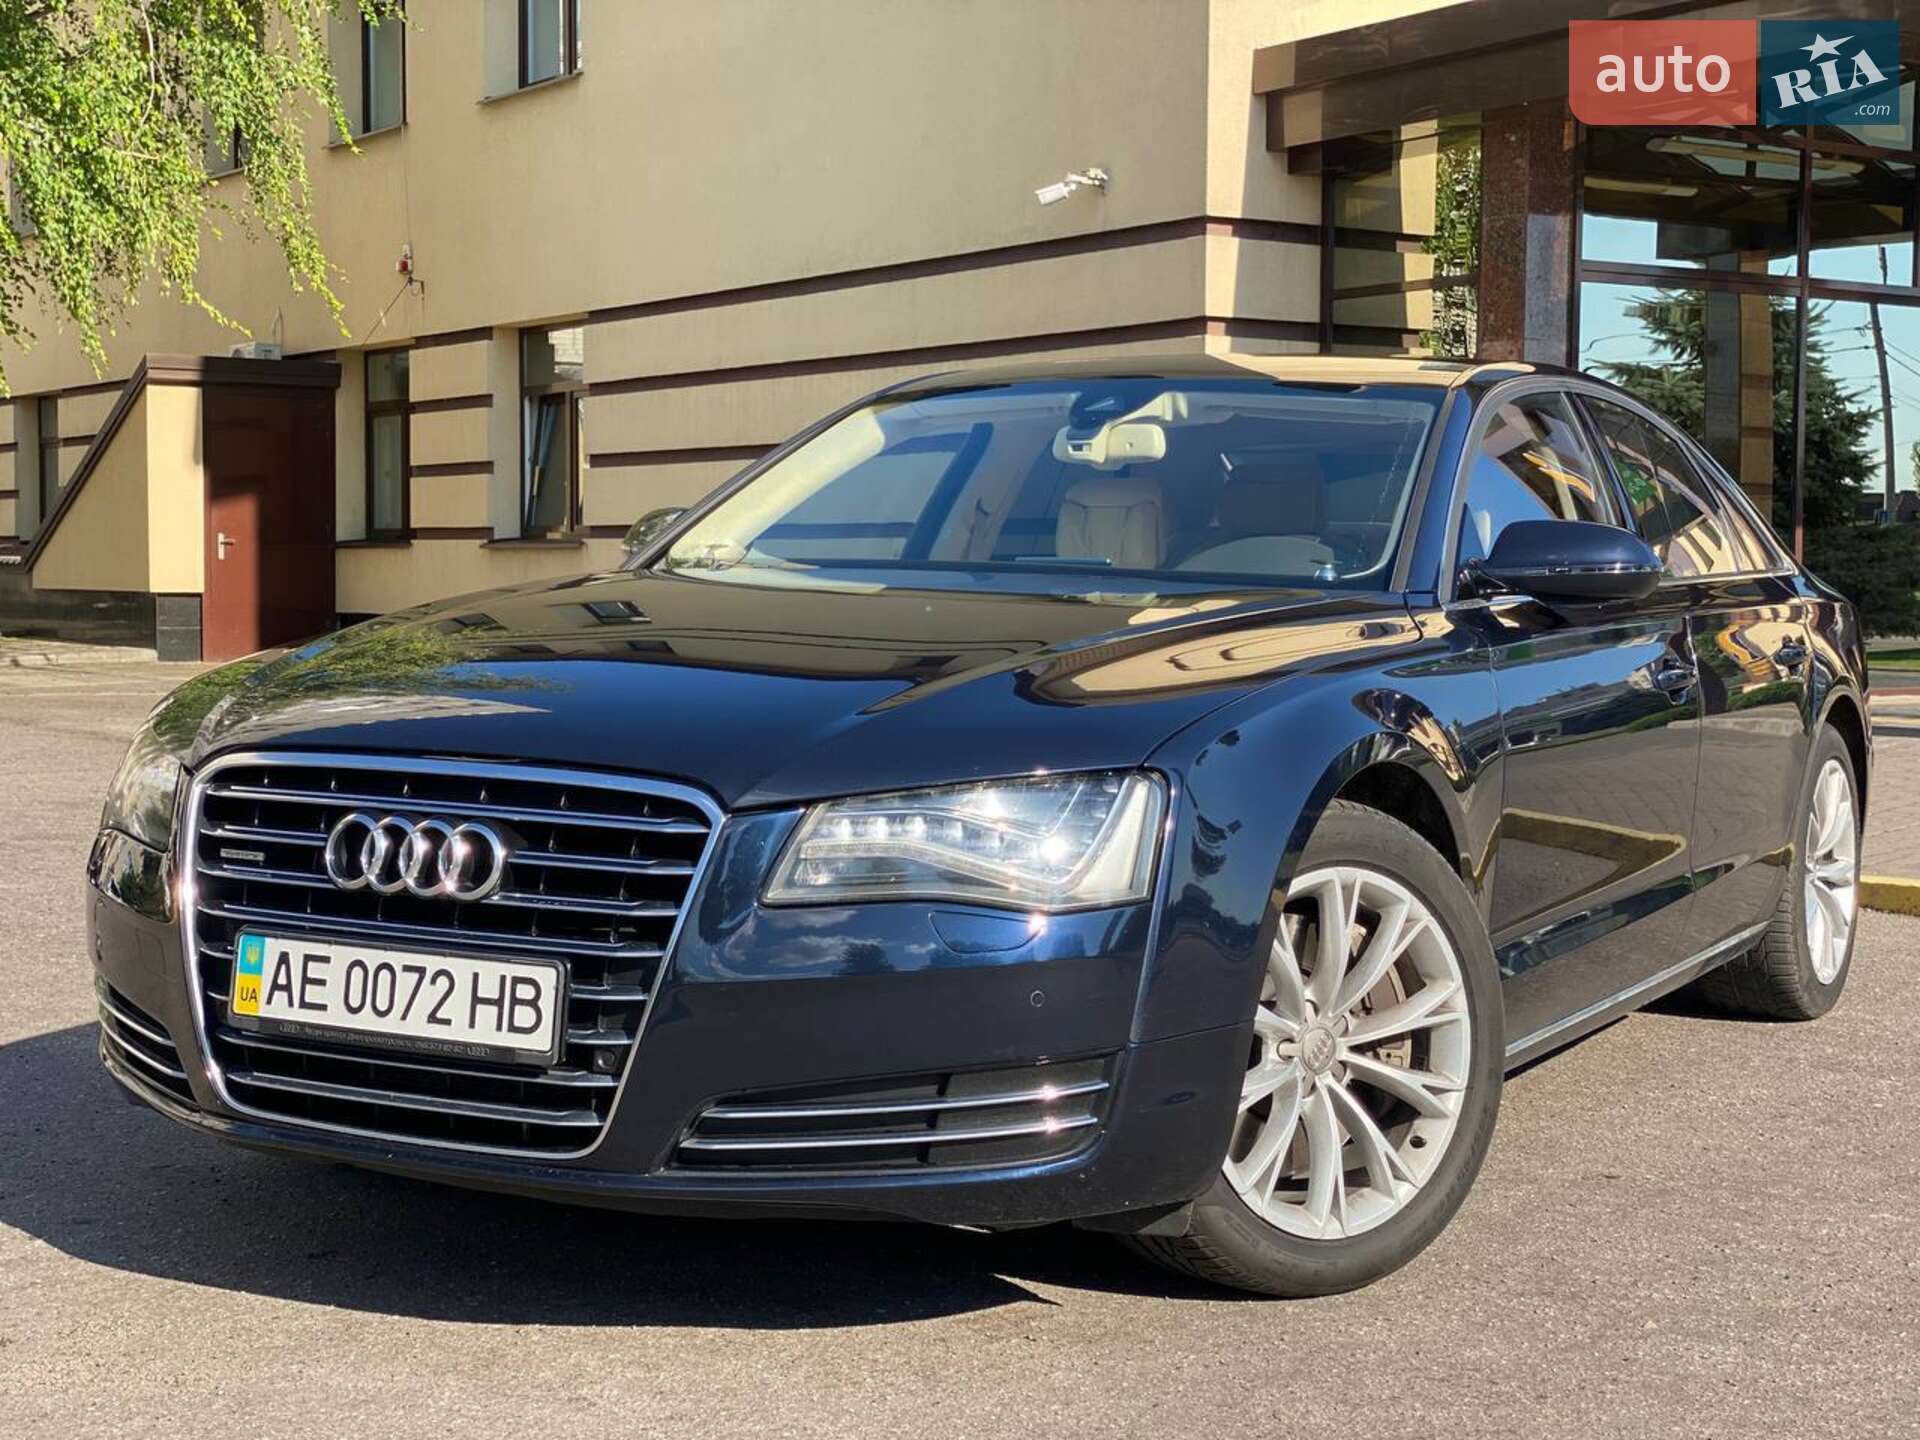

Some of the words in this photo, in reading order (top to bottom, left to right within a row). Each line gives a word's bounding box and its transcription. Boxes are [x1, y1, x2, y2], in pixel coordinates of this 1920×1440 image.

[240, 986, 258, 1002] UA
[266, 951, 332, 1011] AE
[342, 959, 457, 1026] 0072
[468, 972, 543, 1035] HB
